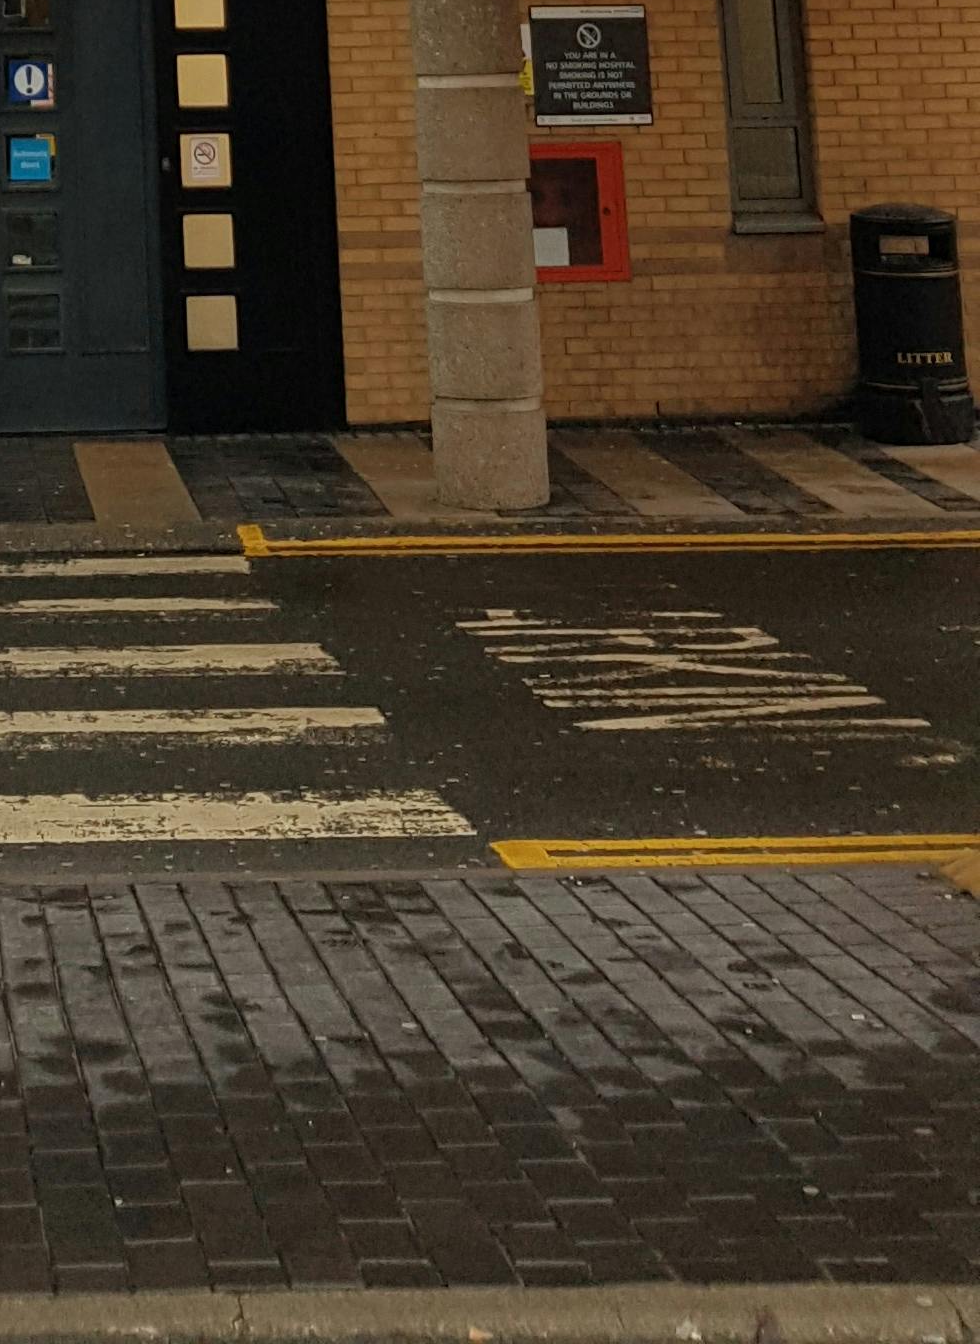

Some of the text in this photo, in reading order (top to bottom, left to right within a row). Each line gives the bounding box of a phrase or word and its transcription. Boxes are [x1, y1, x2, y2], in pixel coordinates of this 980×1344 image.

[610, 51, 617, 59] A
[546, 61, 636, 70] NO SMOKING HOSPITAL
[560, 72, 597, 80] SMOKING
[607, 71, 623, 79] NOT
[553, 92, 562, 100] IN
[580, 91, 620, 99] GROUNDS
[621, 91, 633, 99] OR
[572, 101, 614, 110] BUILDINGS
[897, 352, 953, 364] LITTER
